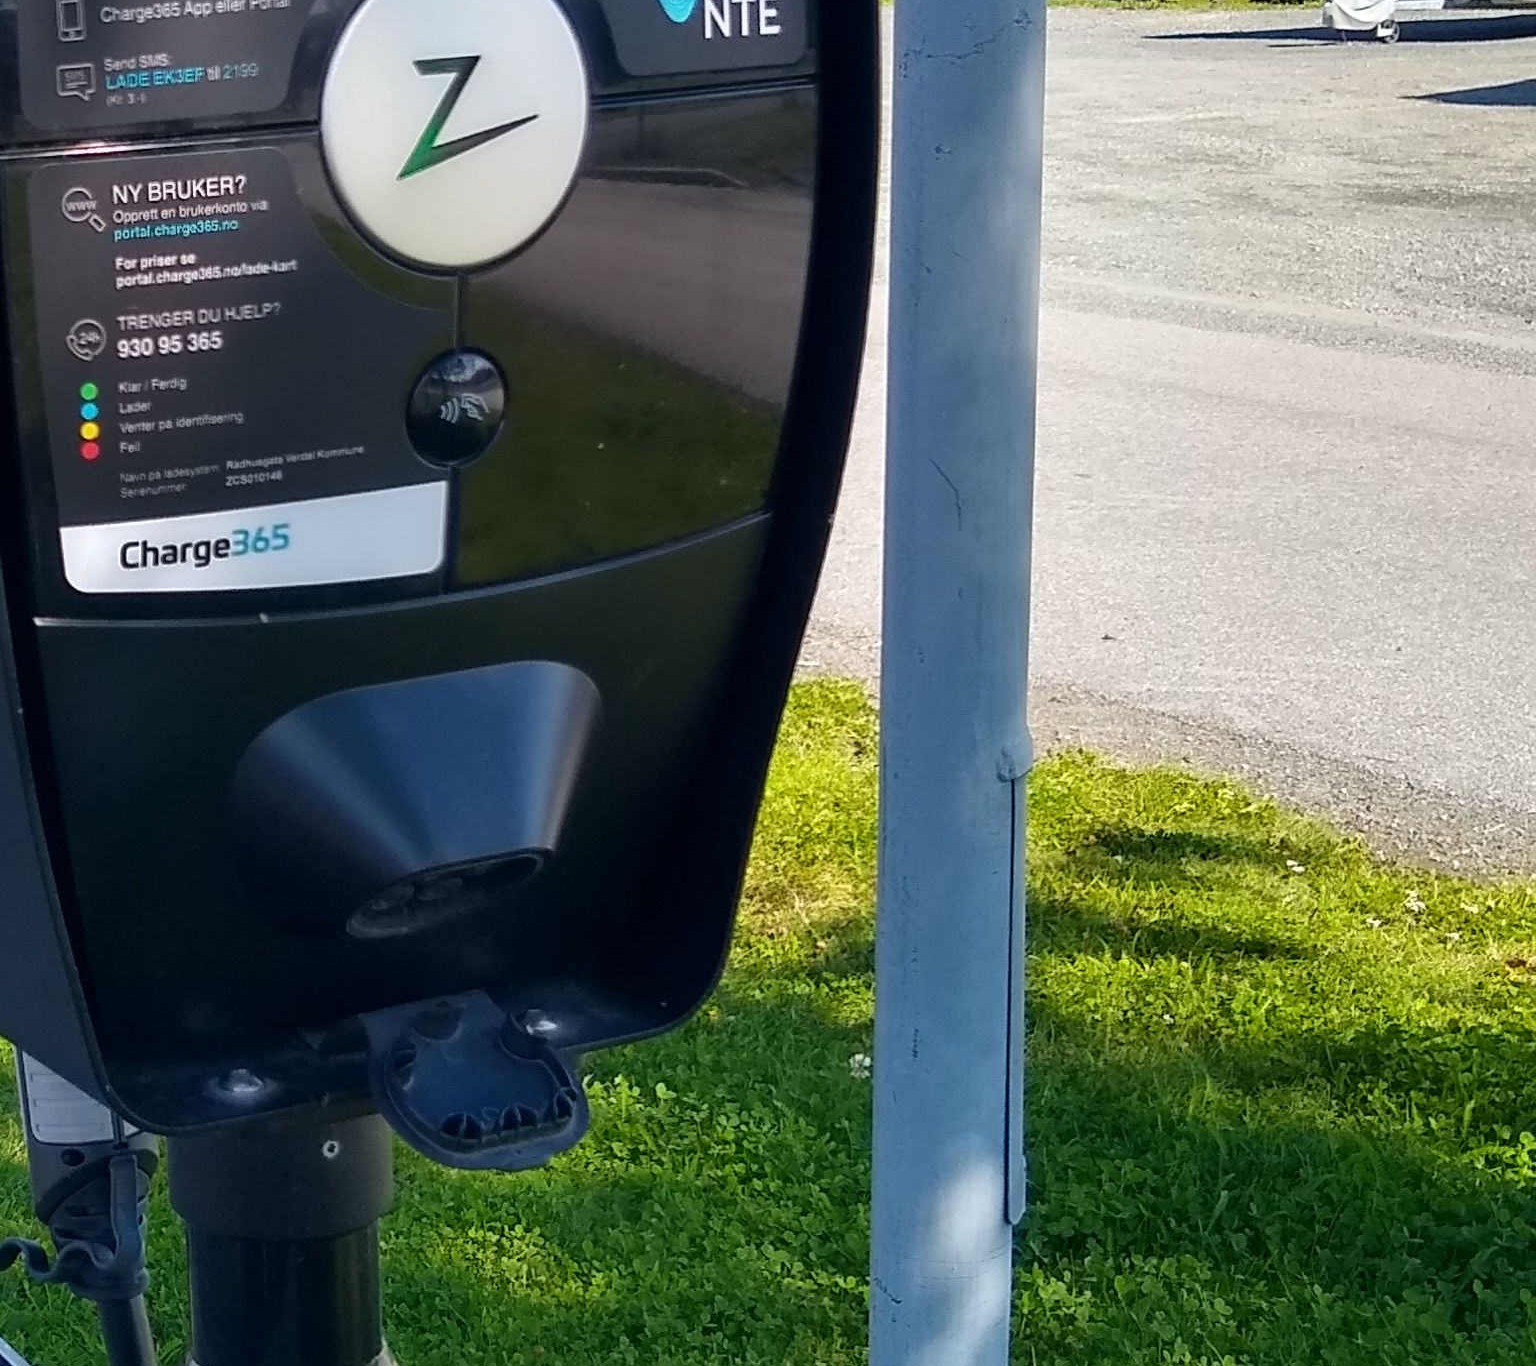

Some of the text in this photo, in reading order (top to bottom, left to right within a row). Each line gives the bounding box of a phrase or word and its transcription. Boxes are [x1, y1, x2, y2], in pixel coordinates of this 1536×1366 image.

[100, 0, 181, 24] Charge365
[183, 0, 213, 17] App
[105, 70, 150, 91] LADE
[152, 66, 205, 87] EK3EF
[113, 175, 247, 205] NY BRUKER?
[114, 208, 159, 225] Opprett
[161, 209, 176, 220] en
[179, 201, 247, 218] brukerkonto
[114, 219, 239, 242] portal.charge365.no
[115, 256, 138, 271] For
[140, 253, 179, 271] priser
[117, 302, 282, 331] TRENGER DU HJELP?
[117, 330, 224, 359] 930 95 365
[119, 523, 291, 570] Charge365
